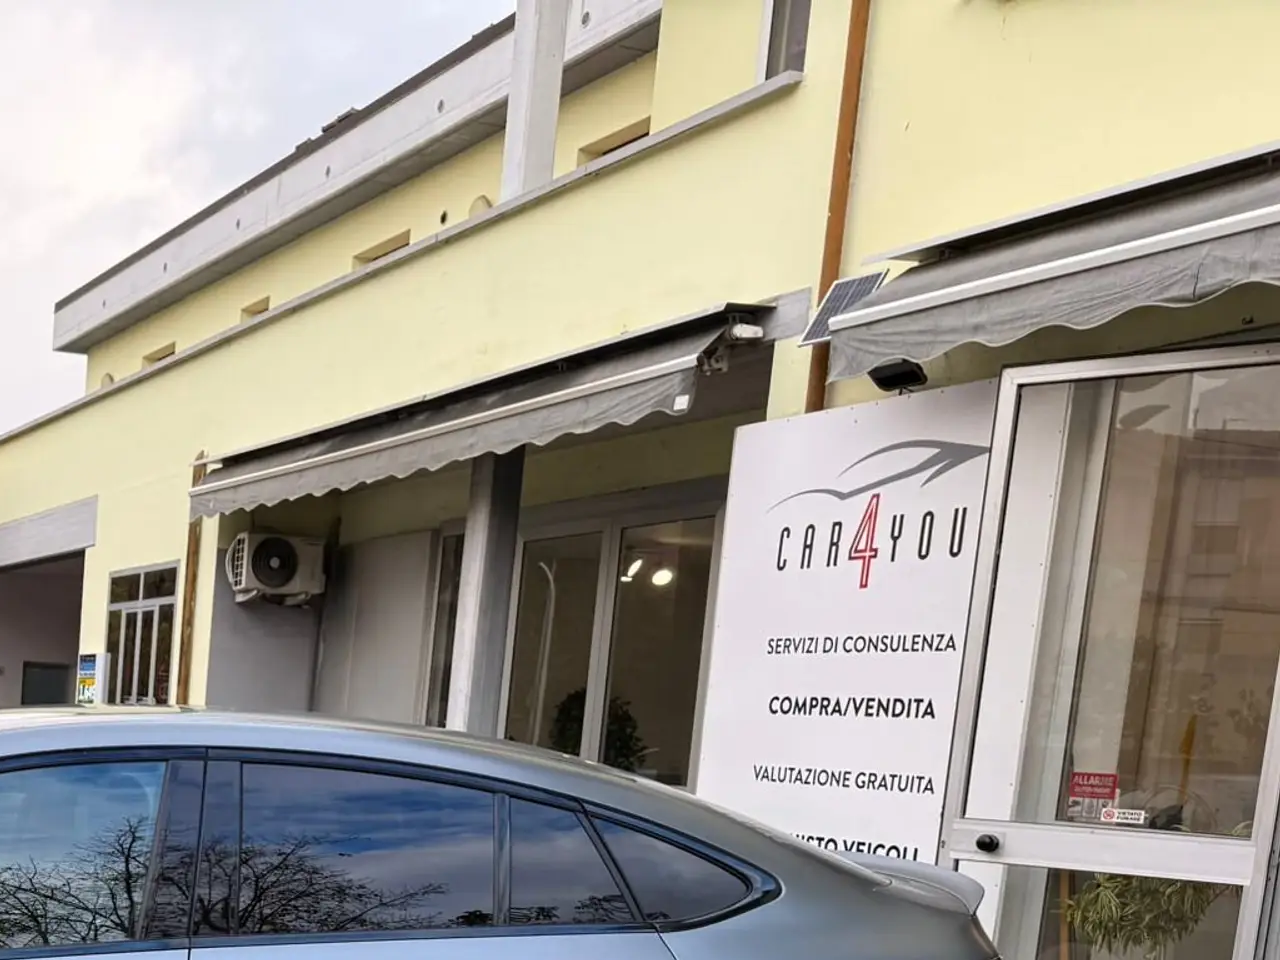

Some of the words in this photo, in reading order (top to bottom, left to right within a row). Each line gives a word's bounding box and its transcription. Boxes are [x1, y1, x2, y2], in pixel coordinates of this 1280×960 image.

[767, 636, 819, 655] SERVIZI
[822, 636, 839, 654] DI
[842, 633, 957, 653] CONSULENZA
[768, 696, 936, 719] COMPRA/VENDITA
[753, 764, 852, 789] VALUTAZIONE
[854, 771, 935, 795] GRATUITA
